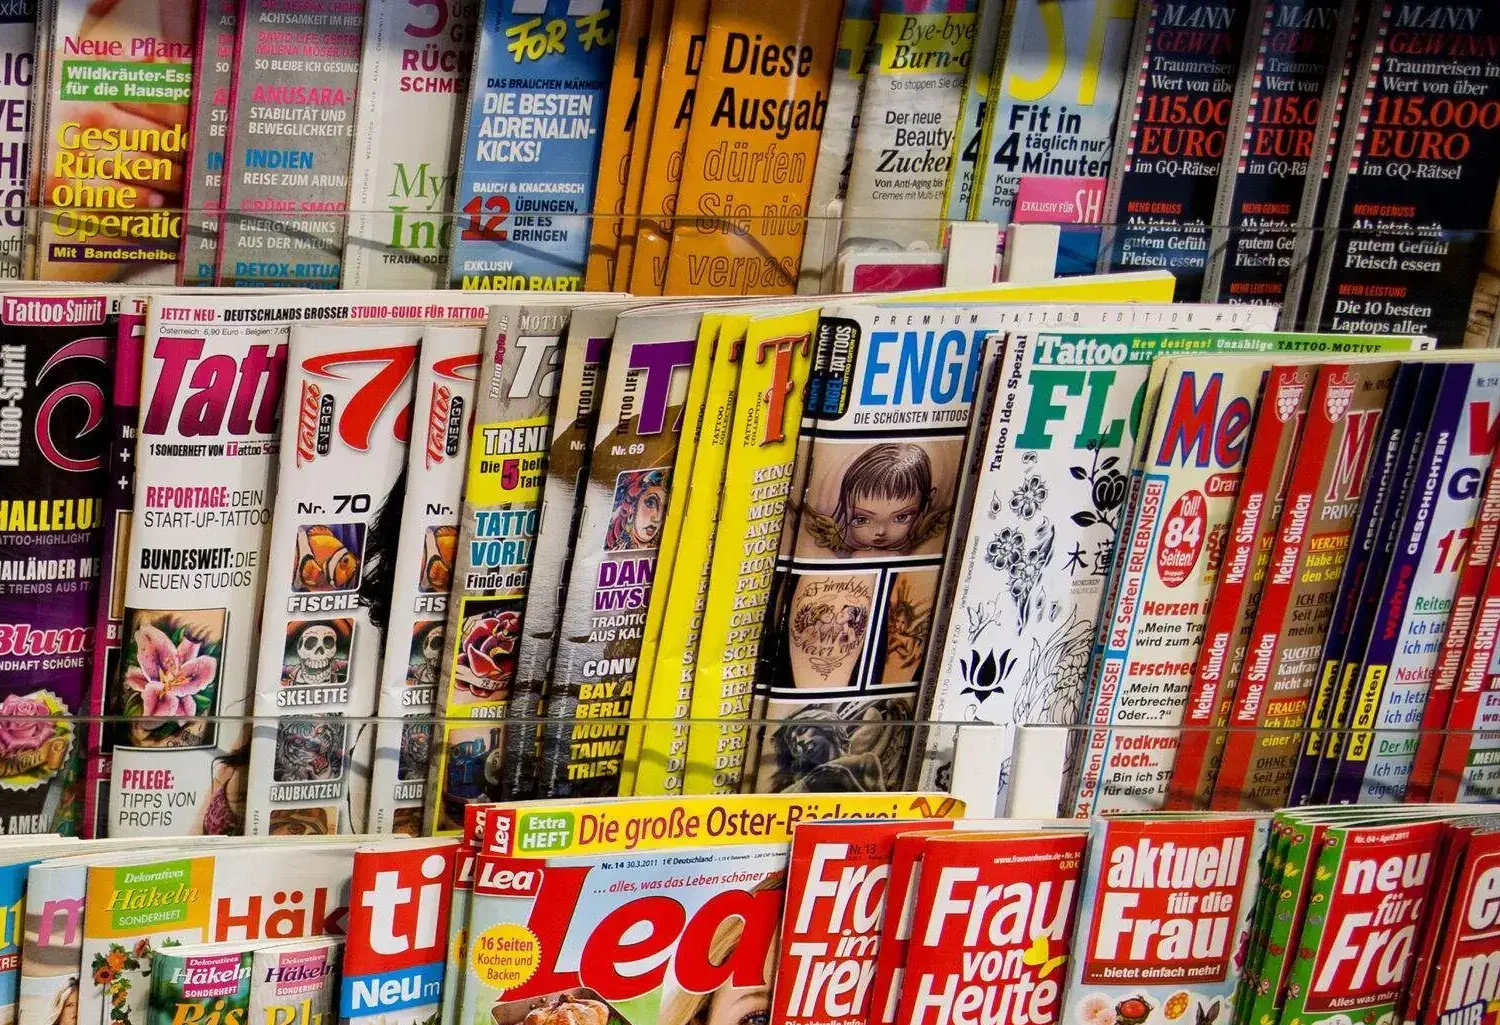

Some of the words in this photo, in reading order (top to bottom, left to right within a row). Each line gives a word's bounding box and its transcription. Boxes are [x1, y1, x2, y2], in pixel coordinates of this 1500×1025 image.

[723, 32, 812, 77] Diese
[483, 94, 509, 115] DIE
[513, 94, 593, 117] BESTEN
[1376, 98, 1500, 128] 115.000
[478, 117, 595, 140] ADRENALIN-
[1009, 105, 1050, 134] Fit
[1059, 109, 1080, 134] in
[477, 142, 540, 163] KICKS!
[1370, 129, 1470, 161] EURO
[55, 154, 173, 182] Rücken
[1363, 163, 1384, 176] im
[1388, 163, 1461, 180] GQ-Rätsel
[1344, 255, 1397, 272] Fleisch
[1398, 259, 1440, 272] essen
[162, 307, 189, 321] JETZT
[192, 308, 214, 321] NEU
[223, 307, 303, 323] DEUTSCHLANDS
[305, 306, 349, 320] GROSSER
[351, 306, 422, 320] STUDIO-GUIDE
[425, 304, 445, 319] FÜR
[1133, 338, 1155, 349] New
[1160, 338, 1210, 351] designs!
[1217, 338, 1274, 353] Unzählige
[1278, 341, 1380, 353] TATTOO-MOTIVE
[317, 393, 334, 456] ENERGY
[854, 414, 873, 426] DIE
[877, 409, 932, 425] SCHÖNSTEN
[147, 488, 230, 508] REPORTAGE:
[298, 501, 327, 514] Nr.
[332, 495, 370, 513] 70
[1407, 432, 1449, 555] GESCHICHTEN
[1165, 516, 1201, 547] 84
[1272, 546, 1293, 585] Meine
[1288, 494, 1311, 550] Sünden
[141, 549, 233, 571] BUNDESWEIT:
[1160, 546, 1195, 571] Seiten!
[288, 594, 360, 613] FISCHE
[278, 688, 348, 707] SKELETTE
[123, 770, 174, 789] PFLEGE:
[121, 792, 160, 808] TIPPS
[163, 791, 196, 807] VON
[270, 783, 342, 802] RAUBKATZEN
[119, 810, 172, 826] PROFIS
[1108, 837, 1244, 889] aktuell
[104, 883, 201, 913] Häkeln
[923, 867, 1073, 947] Frau
[1168, 895, 1196, 914] für
[1200, 894, 1232, 913] die
[119, 911, 181, 927] SONDERHEFT
[1095, 893, 1234, 963] Frau
[502, 866, 784, 1004] Lea
